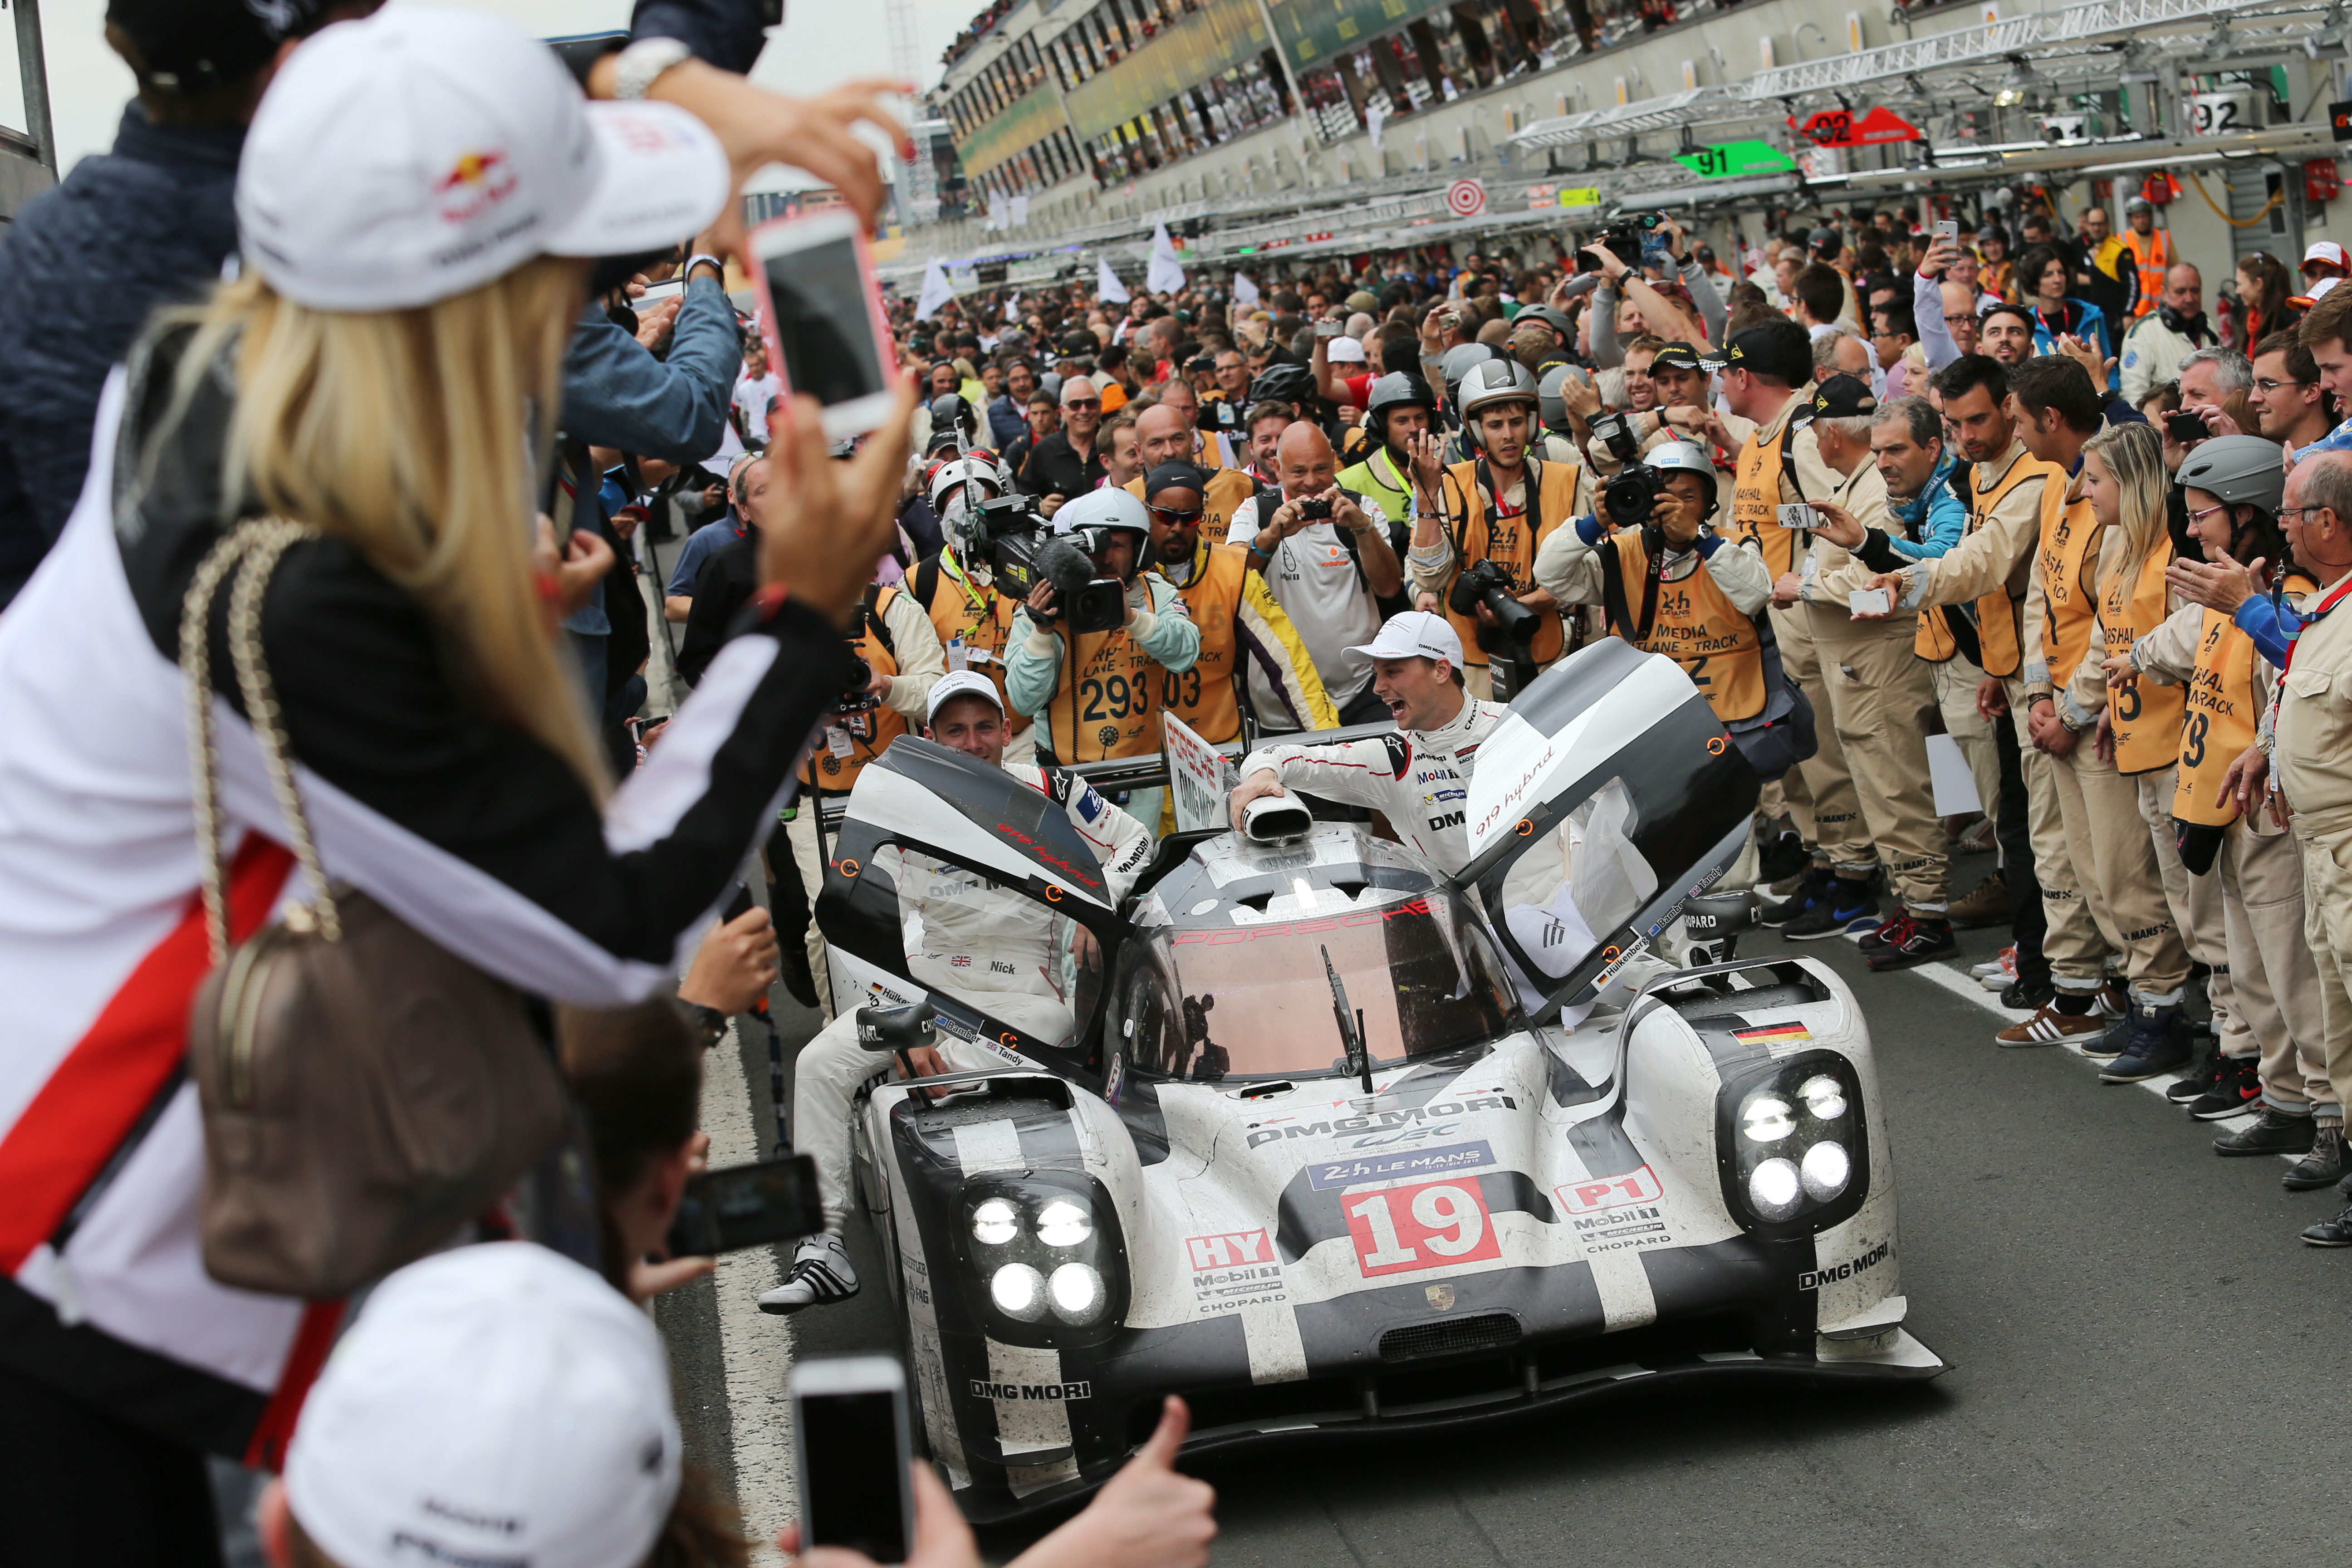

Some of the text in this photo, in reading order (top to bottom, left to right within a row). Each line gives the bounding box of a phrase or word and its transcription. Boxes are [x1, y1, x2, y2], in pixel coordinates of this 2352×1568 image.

[1650, 553, 1661, 575] EOS
[1280, 573, 1292, 581] Mbil
[1656, 623, 1708, 640] MEDIA
[1432, 647, 1446, 656] MORI
[1694, 633, 1739, 652] TRACK
[1080, 671, 1148, 722] 293
[1476, 745, 1556, 838] 919 hybrid
[1823, 813, 1847, 823] MANS
[996, 823, 1033, 844] 919
[1030, 846, 1102, 889] hybrid
[1894, 858, 1927, 871] LE MANS
[1698, 865, 1723, 889] Tandy
[1171, 897, 1446, 948] PORSCHE
[1683, 914, 1717, 928] HOPARD
[2131, 926, 2159, 941] MANS
[1606, 935, 1651, 977] Hülkenberg
[990, 960, 1016, 975] Nick
[2214, 964, 2230, 975] MA
[946, 1020, 981, 1044] Bamber
[998, 1047, 1024, 1066] Tandy
[1246, 1096, 1518, 1150] DMG MORI
[1376, 1160, 1406, 1174] LE
[1411, 1150, 1481, 1169] MANS
[1575, 1178, 1645, 1207] P1
[1350, 1185, 1484, 1268] 19
[1573, 1210, 1637, 1230] Mobil
[1606, 1223, 1664, 1236] MICHELIN
[1189, 1231, 1263, 1269] HY
[1587, 1235, 1671, 1254] CHOPARD
[1800, 1241, 1888, 1289] DMG MORI
[1192, 1269, 1256, 1287] Mobil
[915, 1286, 929, 1304] FAG
[1222, 1282, 1281, 1295] MICHELIN
[1199, 1294, 1287, 1313] CHOPARD
[970, 1380, 1090, 1400] DMG MORI
